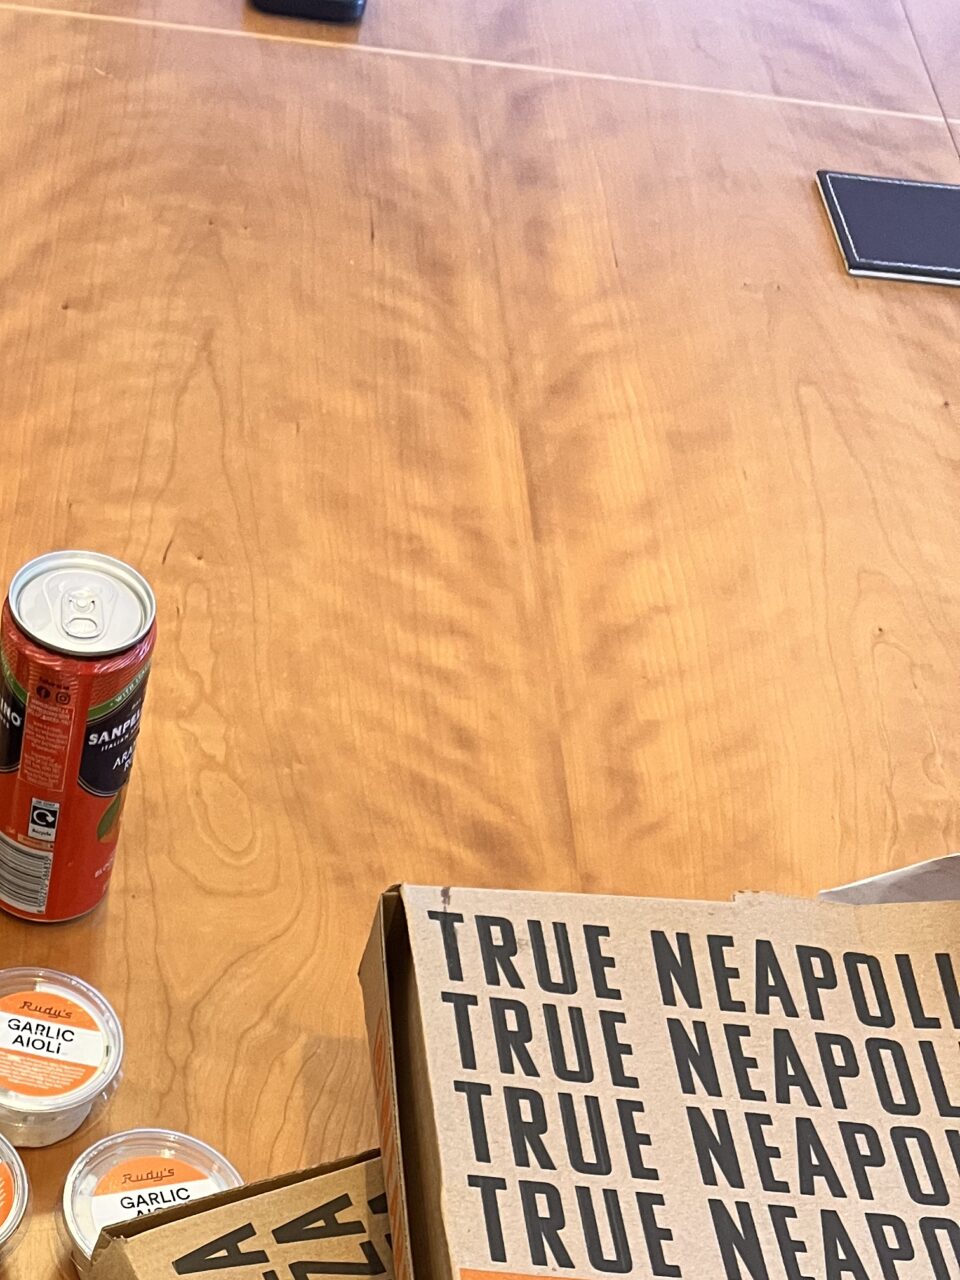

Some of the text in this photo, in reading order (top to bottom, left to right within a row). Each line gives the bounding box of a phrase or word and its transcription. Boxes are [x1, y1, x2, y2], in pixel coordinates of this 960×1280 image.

[428, 909, 622, 1002] TRUE
[7, 1018, 75, 1042] GARLIC
[18, 1000, 73, 1020] Rudy's
[440, 991, 640, 1089] TRUE
[454, 1080, 960, 1207] TRUE NEAPO
[120, 1187, 191, 1210] GARLIC
[121, 1167, 175, 1185] Rudy's
[467, 1174, 683, 1279] TRUE
